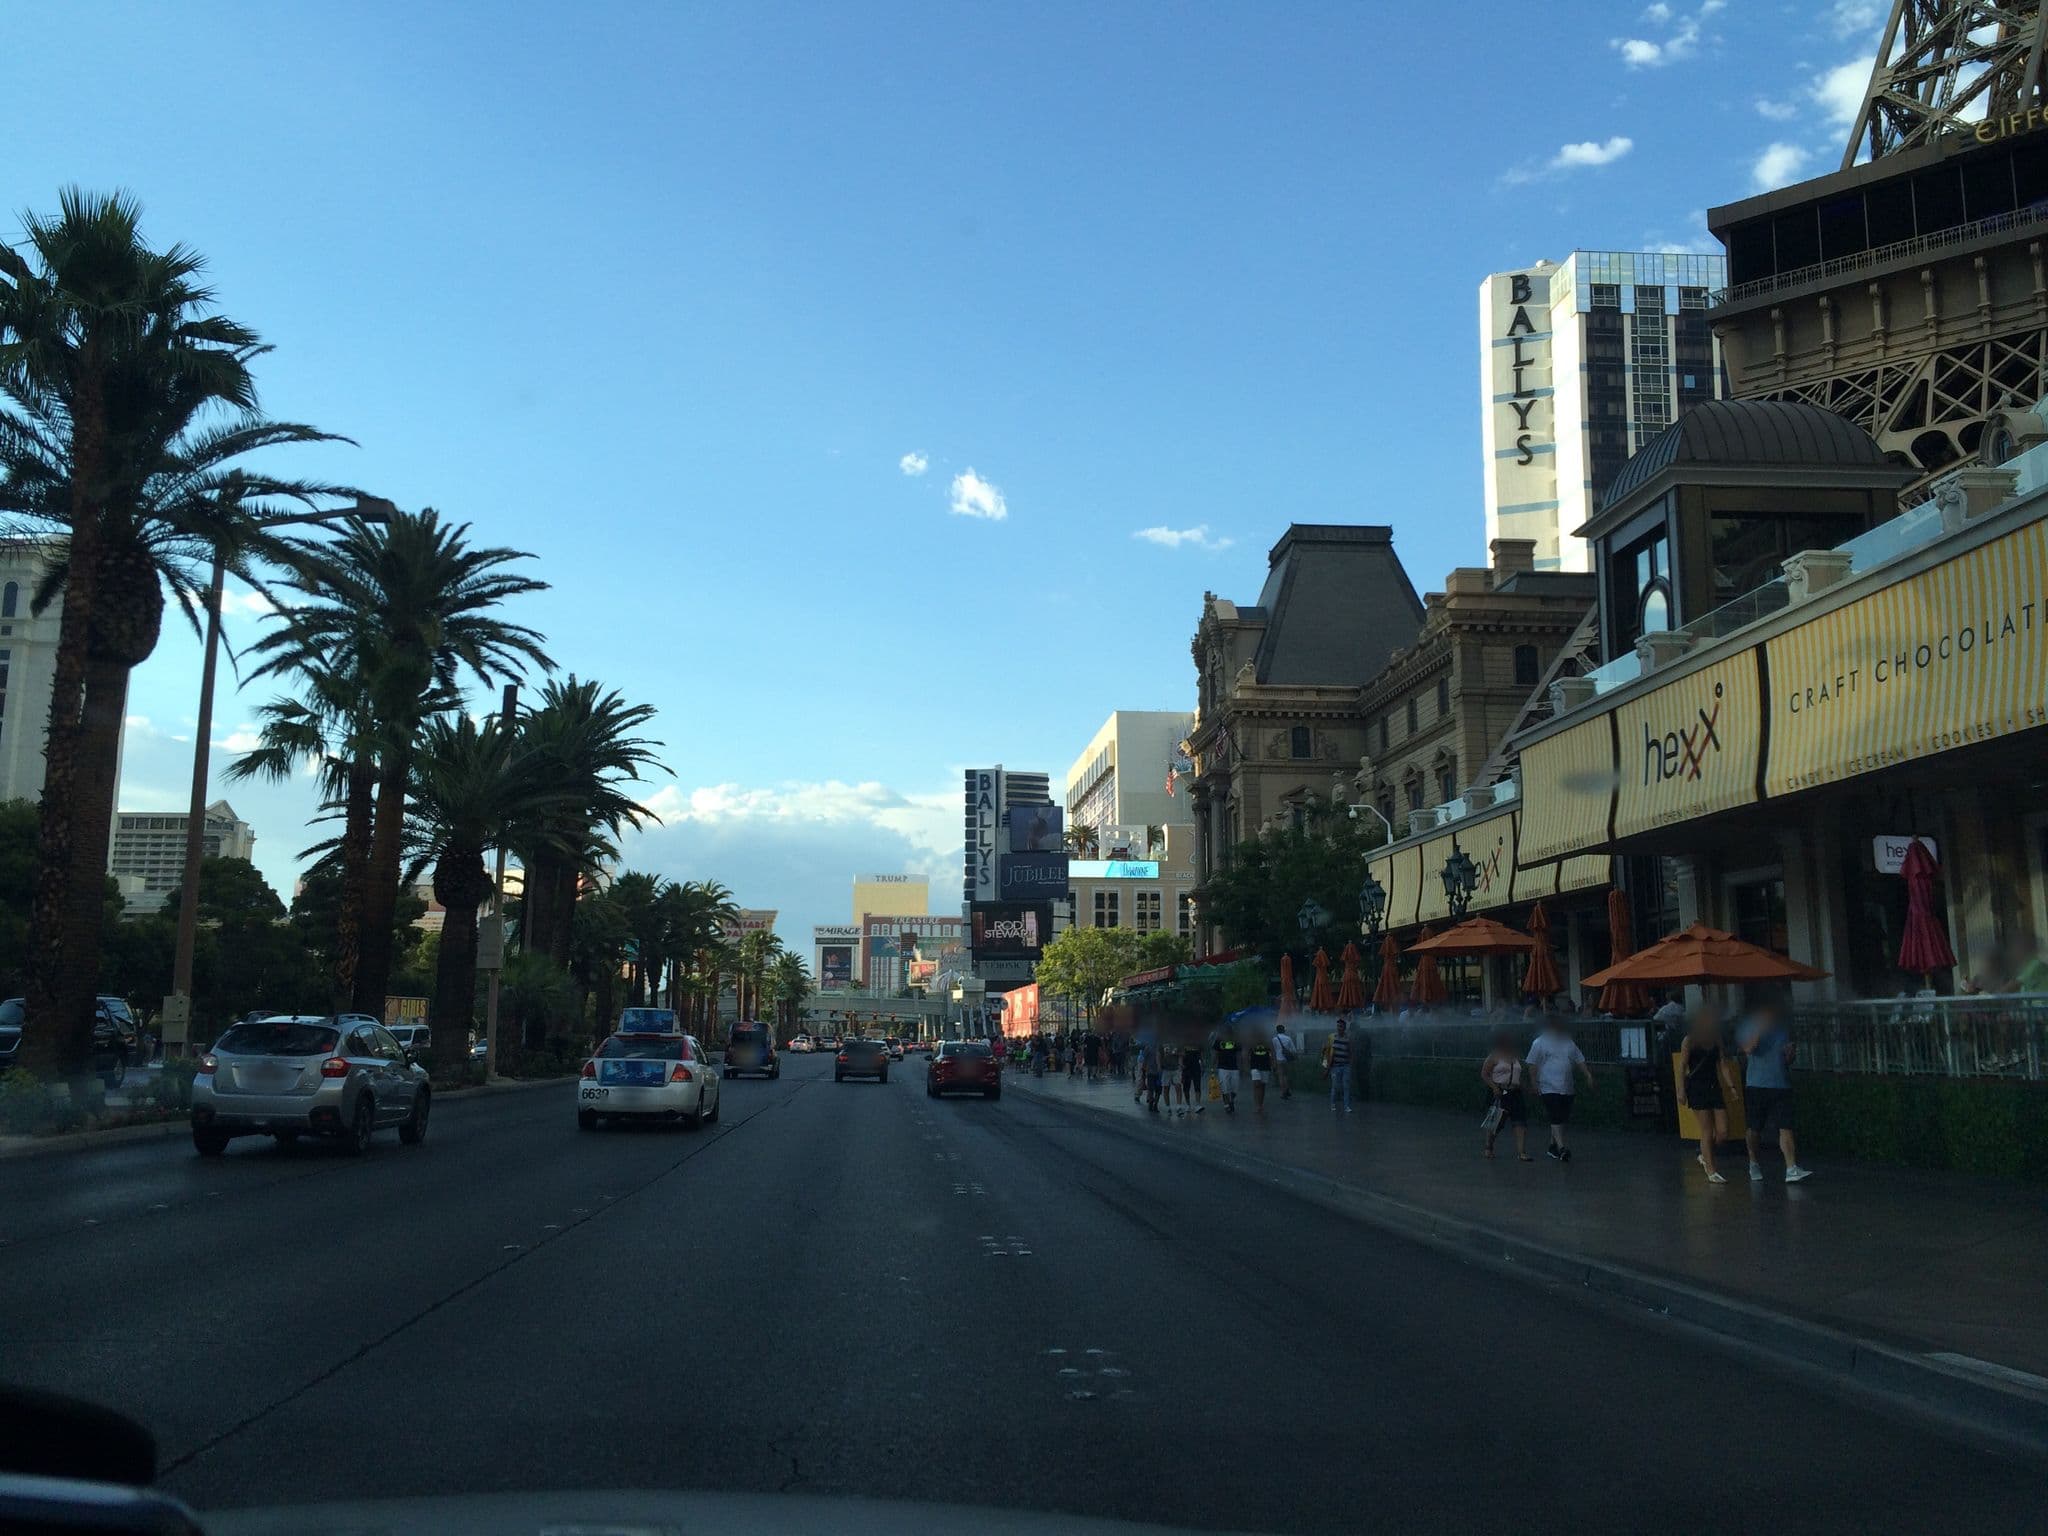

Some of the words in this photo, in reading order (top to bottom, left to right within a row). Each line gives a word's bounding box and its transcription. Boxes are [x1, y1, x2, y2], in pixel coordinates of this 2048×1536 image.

[1508, 273, 1538, 467] BALLYS
[1790, 669, 1859, 713] CRAFT
[1644, 700, 1721, 786] hexx
[1866, 746, 1904, 768] CREAM
[1931, 722, 1993, 749] COOKIES
[977, 773, 993, 886] BALLYS
[1885, 842, 1909, 858] he
[875, 875, 908, 883] TRUMP
[1002, 866, 1067, 887] JUBILEE
[1475, 847, 1502, 893] exx
[726, 920, 766, 929] CASARS
[892, 917, 940, 925] TREASURE
[994, 920, 1023, 931] ROD
[819, 927, 861, 936] MIRAGE
[984, 929, 1034, 939] STEWART
